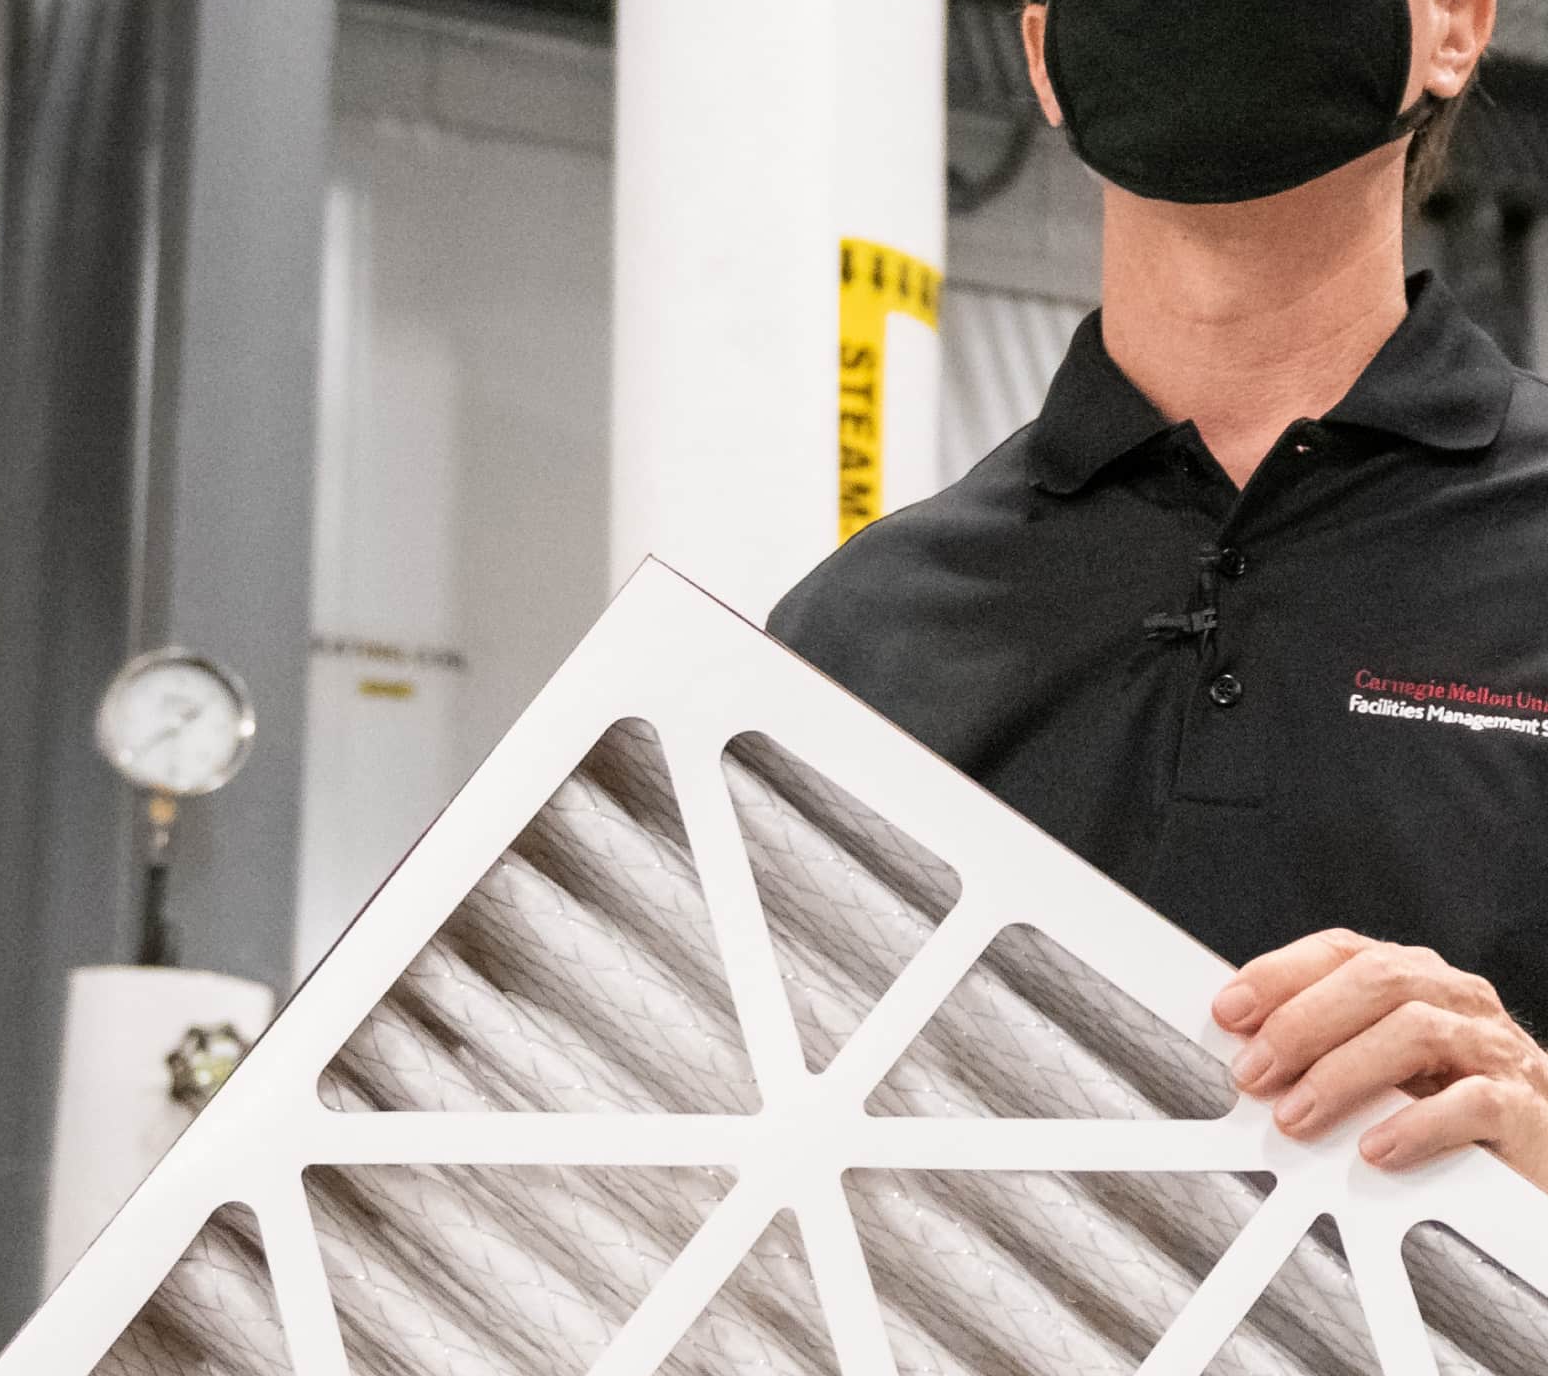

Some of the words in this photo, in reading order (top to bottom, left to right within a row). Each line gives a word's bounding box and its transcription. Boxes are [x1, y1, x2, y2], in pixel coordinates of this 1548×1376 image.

[840, 342, 876, 517] STEAM
[1355, 669, 1445, 701] Carnegie
[1448, 682, 1513, 708] Mellon
[1349, 694, 1425, 720] Facilities
[1426, 703, 1540, 737] Management
